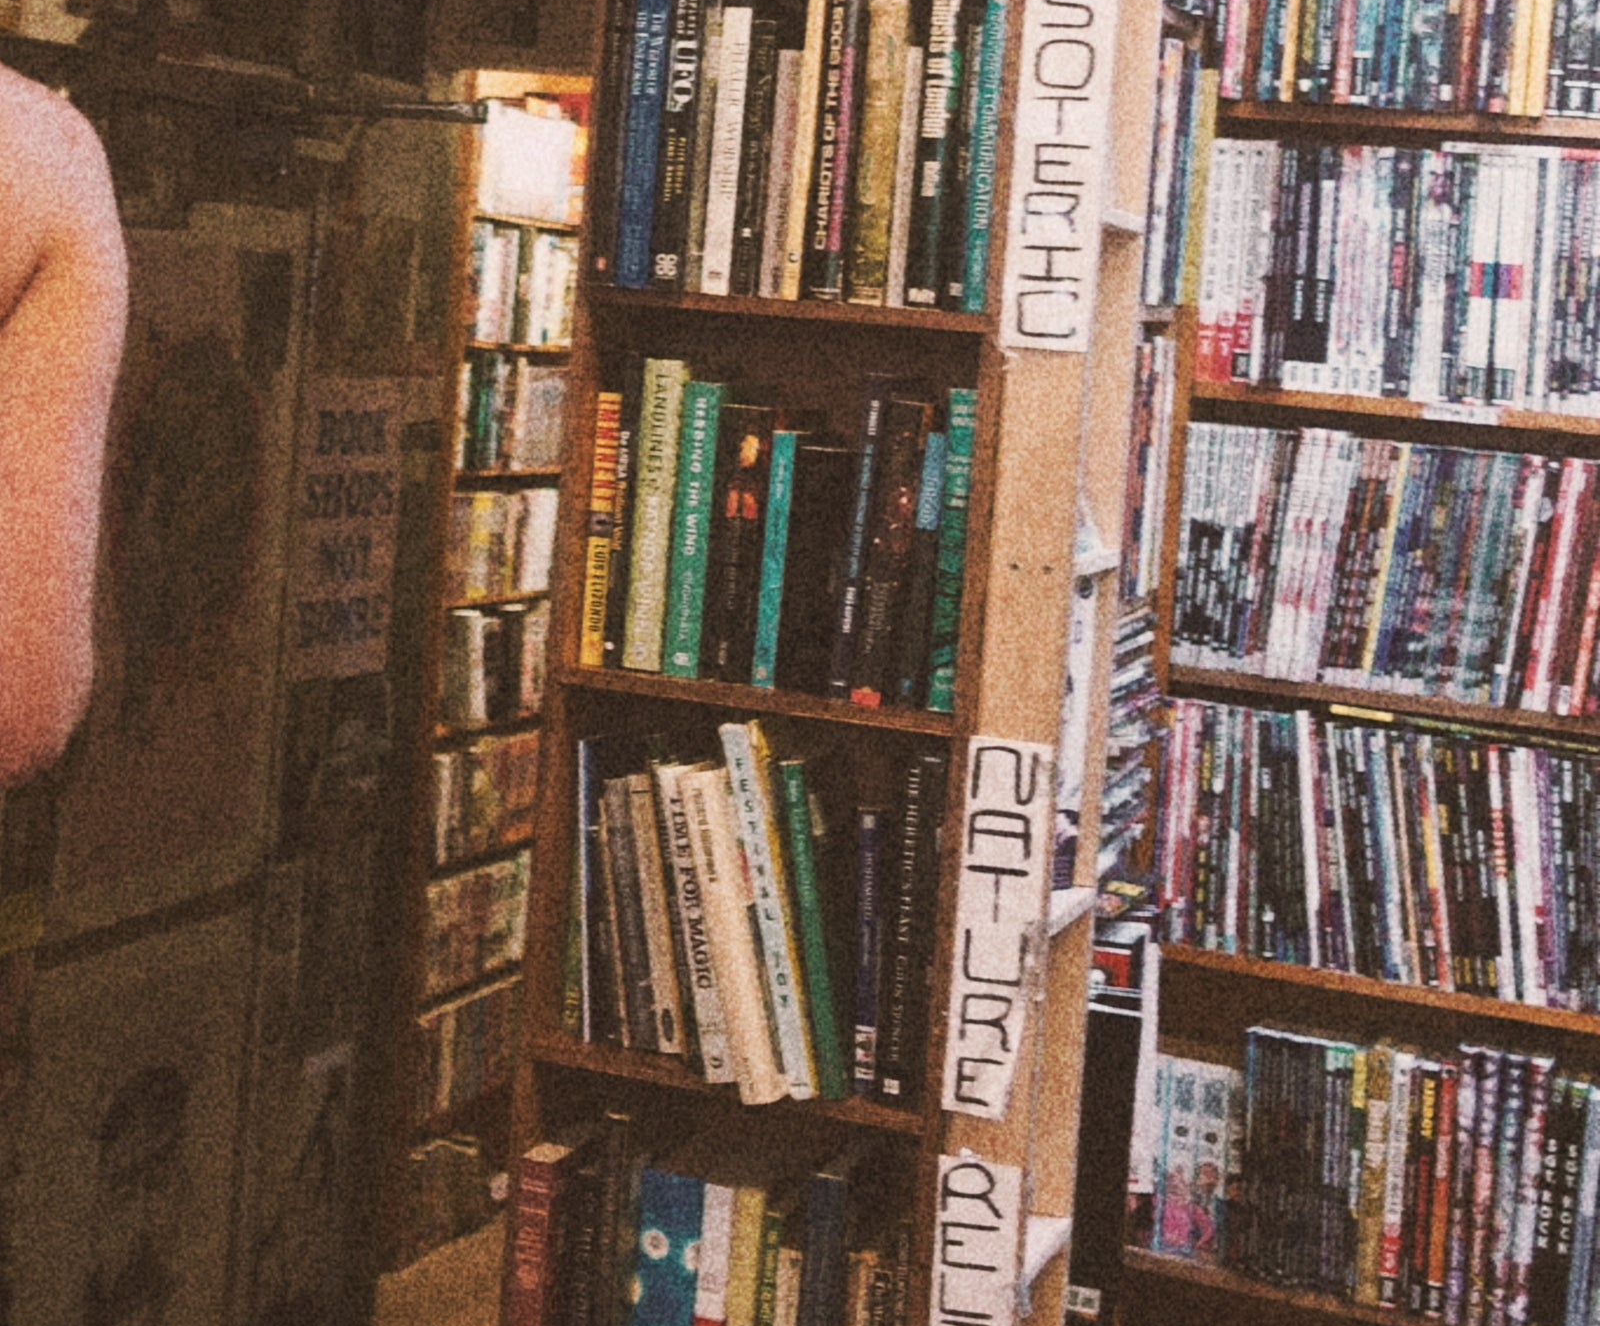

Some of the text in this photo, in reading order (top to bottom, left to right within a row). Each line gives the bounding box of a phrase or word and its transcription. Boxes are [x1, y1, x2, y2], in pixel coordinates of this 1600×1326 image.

[822, 113, 840, 142] OF
[826, 69, 842, 109] THE
[921, 78, 951, 139] London
[813, 144, 837, 250] CHARIOTS
[972, 92, 997, 230] COMMUNICATION
[645, 373, 671, 473] LANDLINES
[682, 514, 699, 558] WIND
[906, 767, 922, 798] THE
[668, 796, 713, 990] TIME FOR MAGIC
[953, 745, 1041, 1108] NATURE
